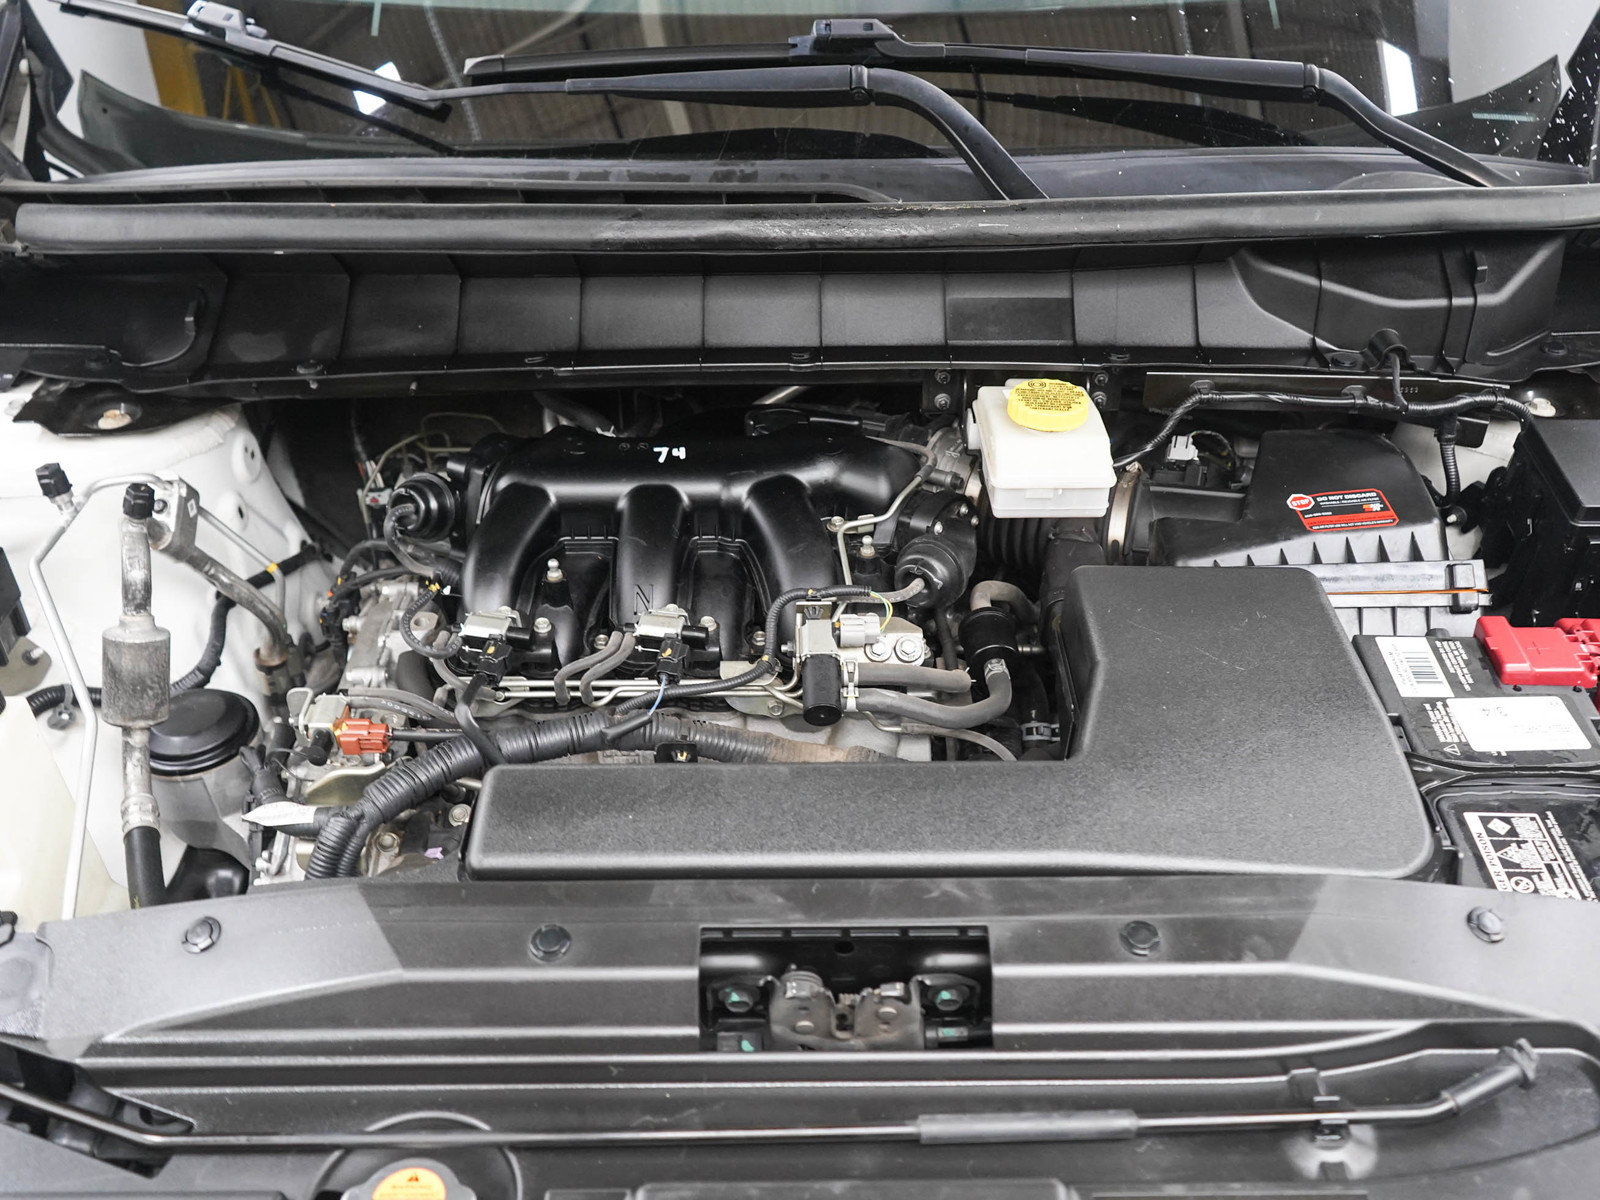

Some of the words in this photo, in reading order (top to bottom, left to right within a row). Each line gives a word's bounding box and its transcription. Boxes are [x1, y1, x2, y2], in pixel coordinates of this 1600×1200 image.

[653, 446, 686, 463] 74
[1291, 498, 1310, 507] STOP
[1476, 832, 1498, 867] POISON
[1494, 871, 1508, 891] GER
